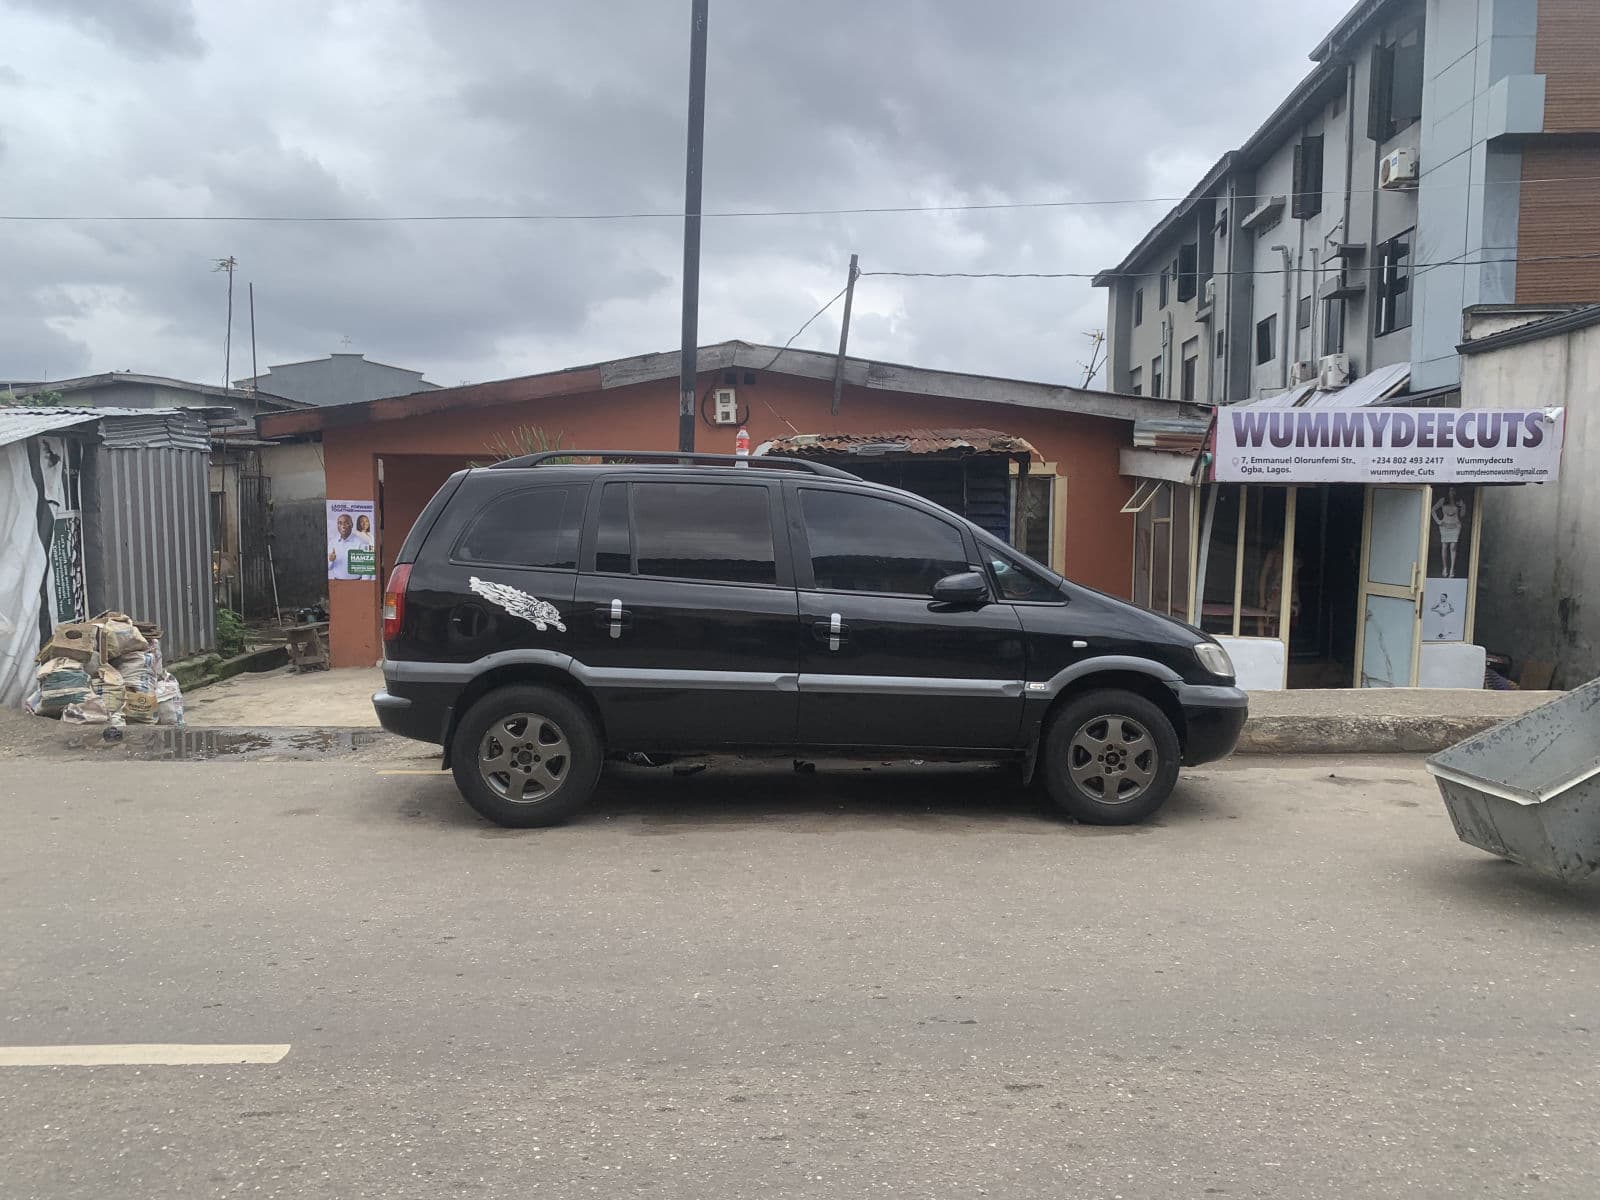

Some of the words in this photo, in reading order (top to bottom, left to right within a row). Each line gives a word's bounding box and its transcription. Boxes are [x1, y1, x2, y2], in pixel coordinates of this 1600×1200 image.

[1232, 412, 1544, 448] WUMMYDEECUTS
[1241, 457, 1248, 465] 7,
[1250, 456, 1292, 464] Emmanuel
[1295, 456, 1340, 464] Olorunfemi
[1341, 457, 1356, 465] Str.,
[1456, 457, 1513, 466] Wummydecuts
[1241, 466, 1264, 475] Ogba,
[1267, 466, 1292, 475] Lagos.
[1370, 468, 1435, 477] wummydee_Cuts
